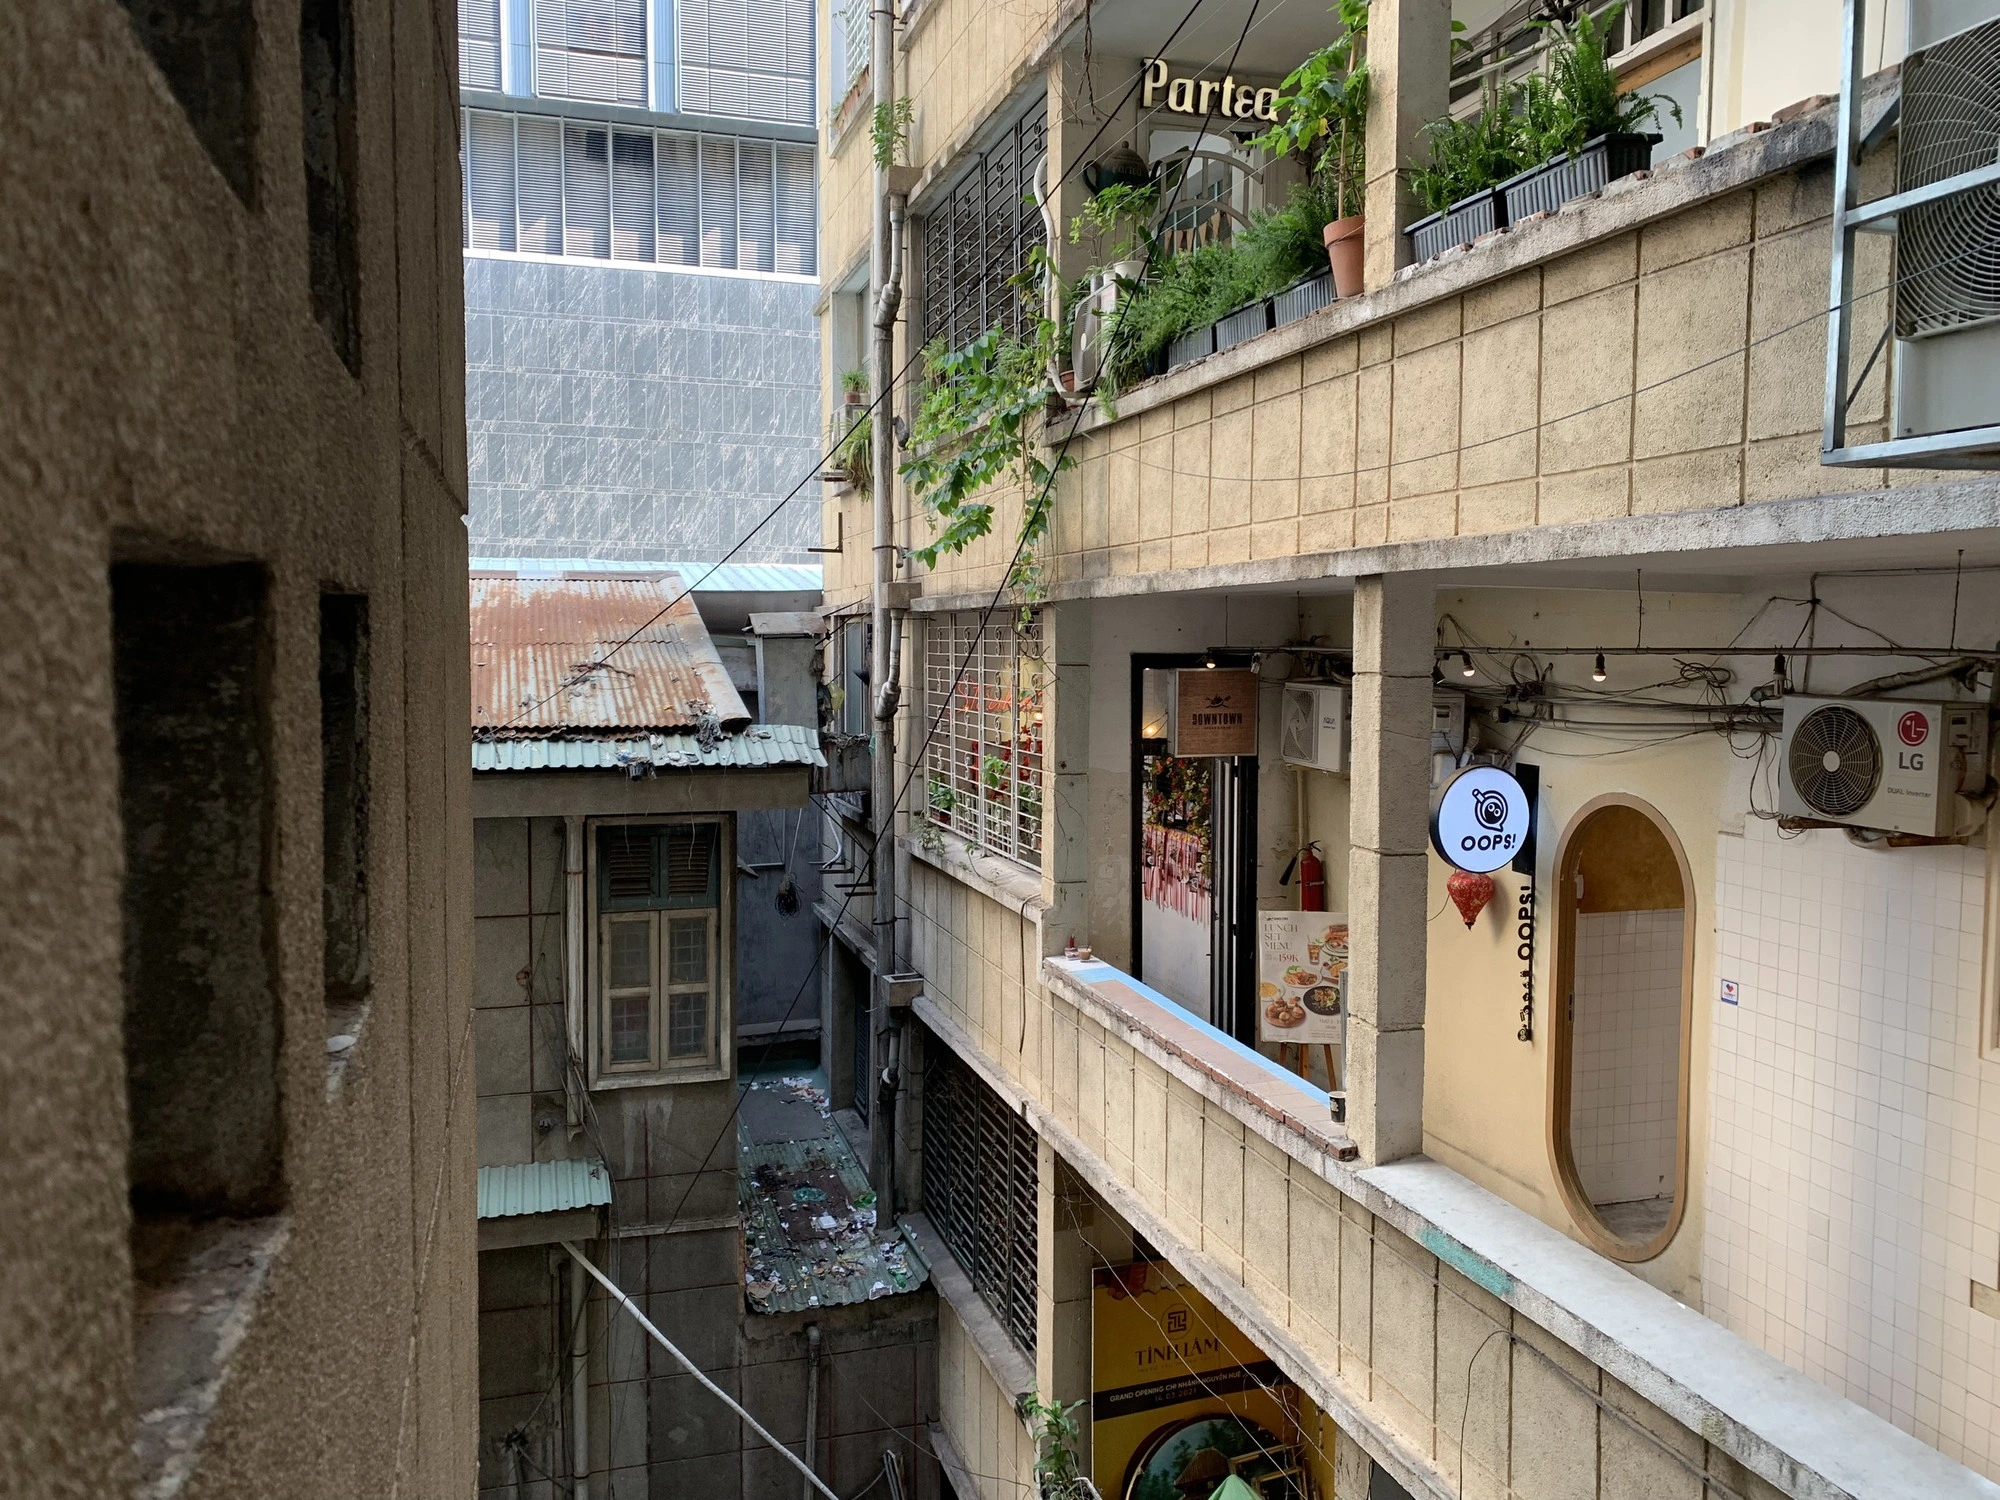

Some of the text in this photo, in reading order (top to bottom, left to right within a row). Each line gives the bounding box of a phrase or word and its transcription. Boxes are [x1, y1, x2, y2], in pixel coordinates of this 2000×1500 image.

[1141, 57, 1281, 122] Partea
[1192, 712, 1243, 726] DOWNTOWN
[1899, 752, 1923, 770] LG
[1887, 787, 1904, 795] DUAL
[1461, 833, 1517, 851] OOPS!
[1264, 923, 1298, 932] LUNCH
[1517, 885, 1535, 961] OOPS!
[1264, 932, 1281, 941] SET
[1264, 941, 1292, 950] MENU
[1279, 953, 1299, 963] 159K
[1109, 1391, 1133, 1402] GRAND
[1134, 1386, 1164, 1398] OPENING
